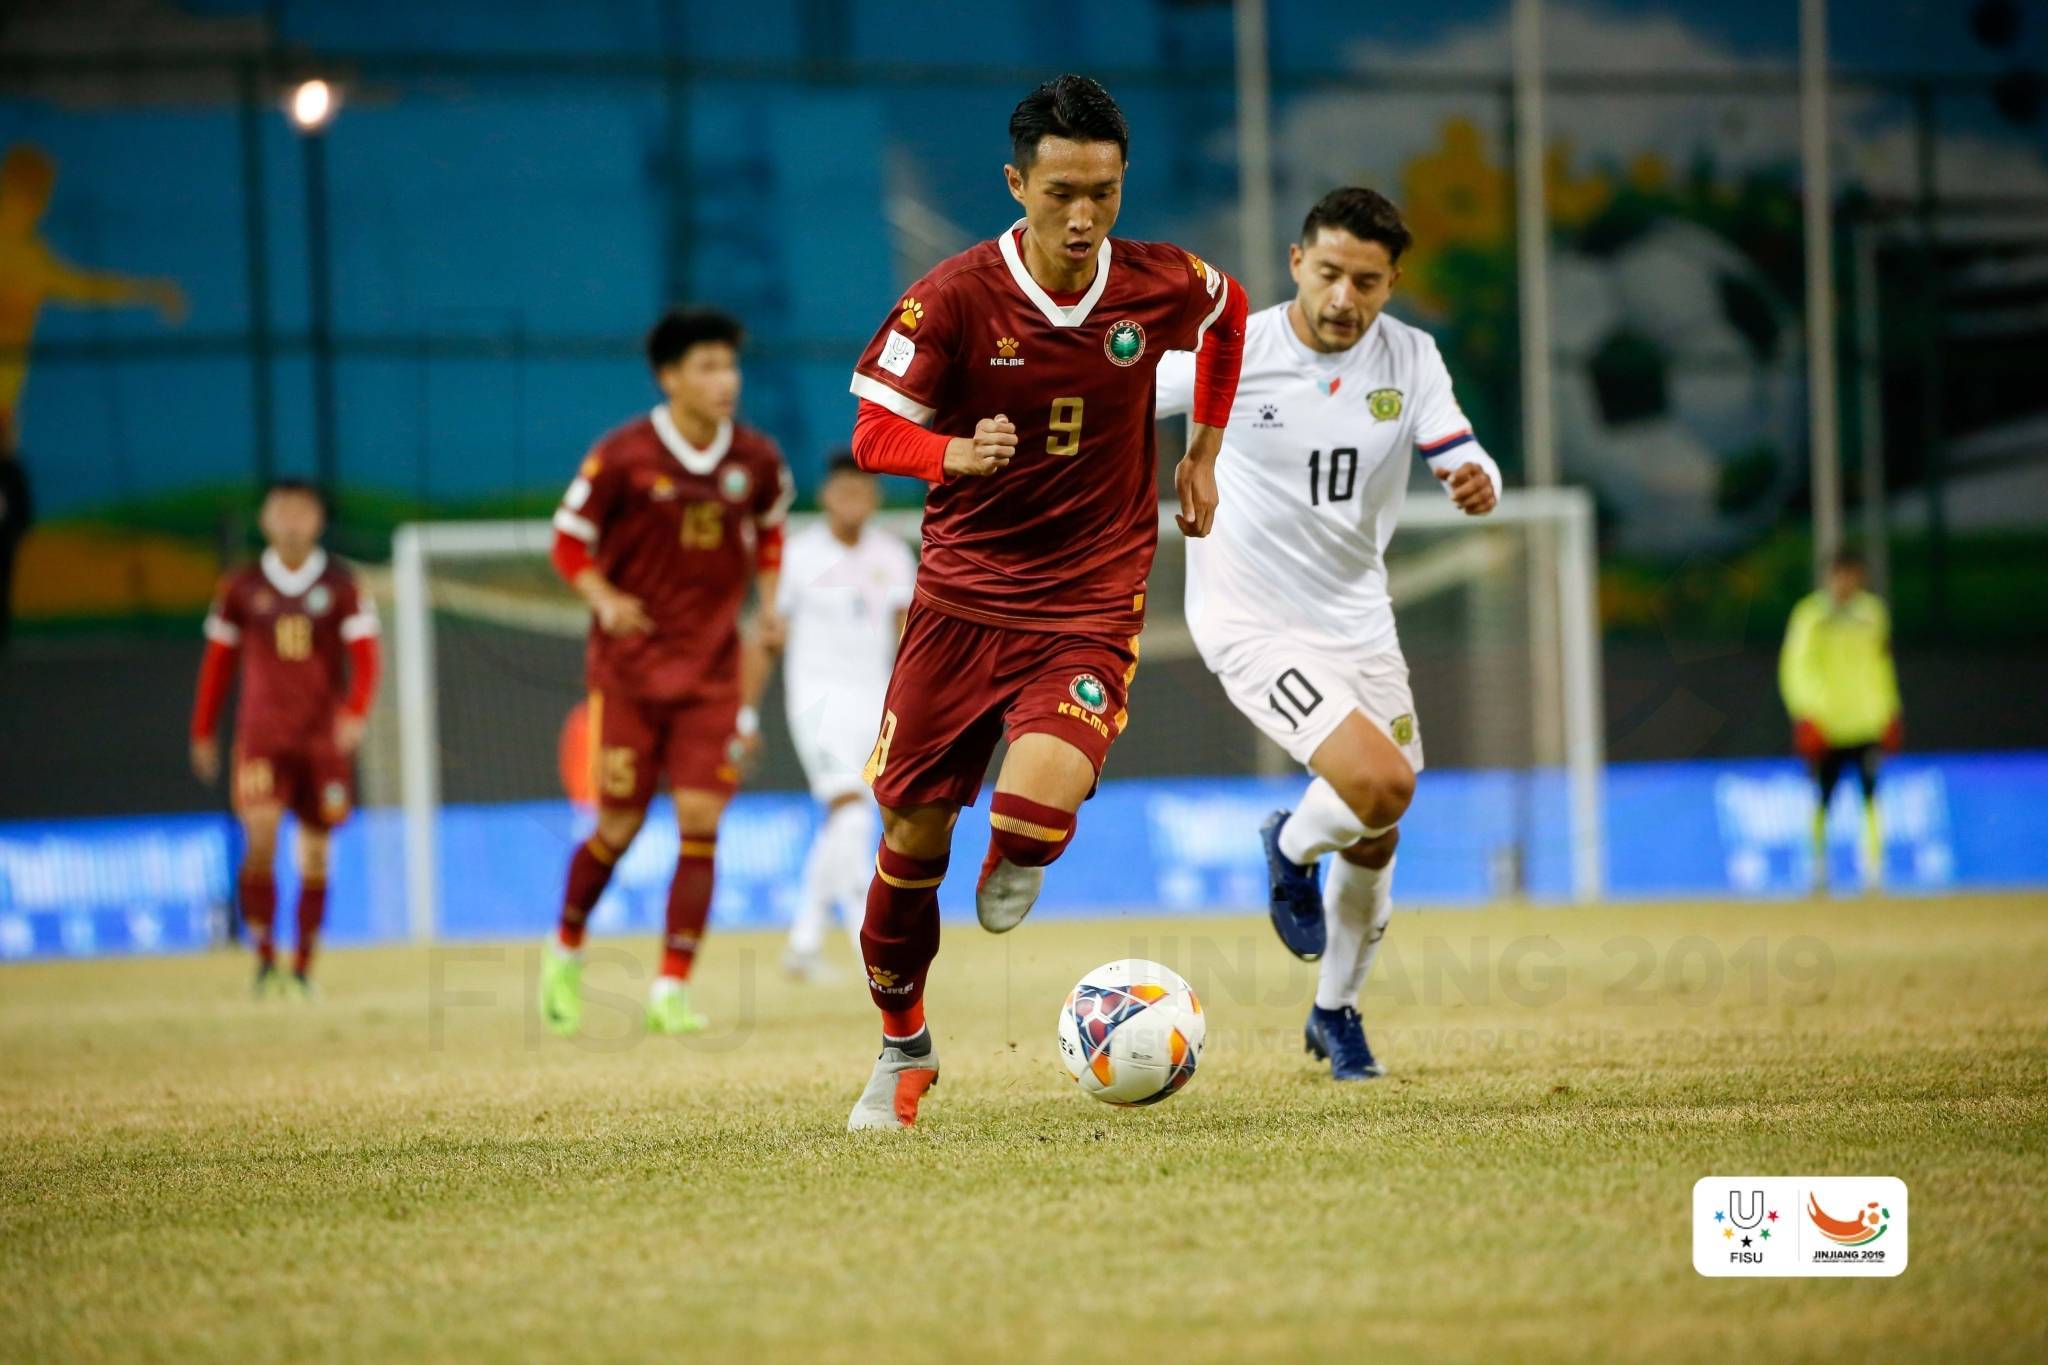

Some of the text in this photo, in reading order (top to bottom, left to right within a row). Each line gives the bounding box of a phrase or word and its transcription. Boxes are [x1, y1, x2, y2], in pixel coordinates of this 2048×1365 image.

[990, 357, 1025, 367] KELME
[1045, 397, 1084, 456] 9
[1308, 447, 1358, 506] 10
[680, 503, 723, 550] 15
[1057, 701, 1109, 739] KELME
[1269, 667, 1324, 731] 10
[604, 746, 636, 798] 15
